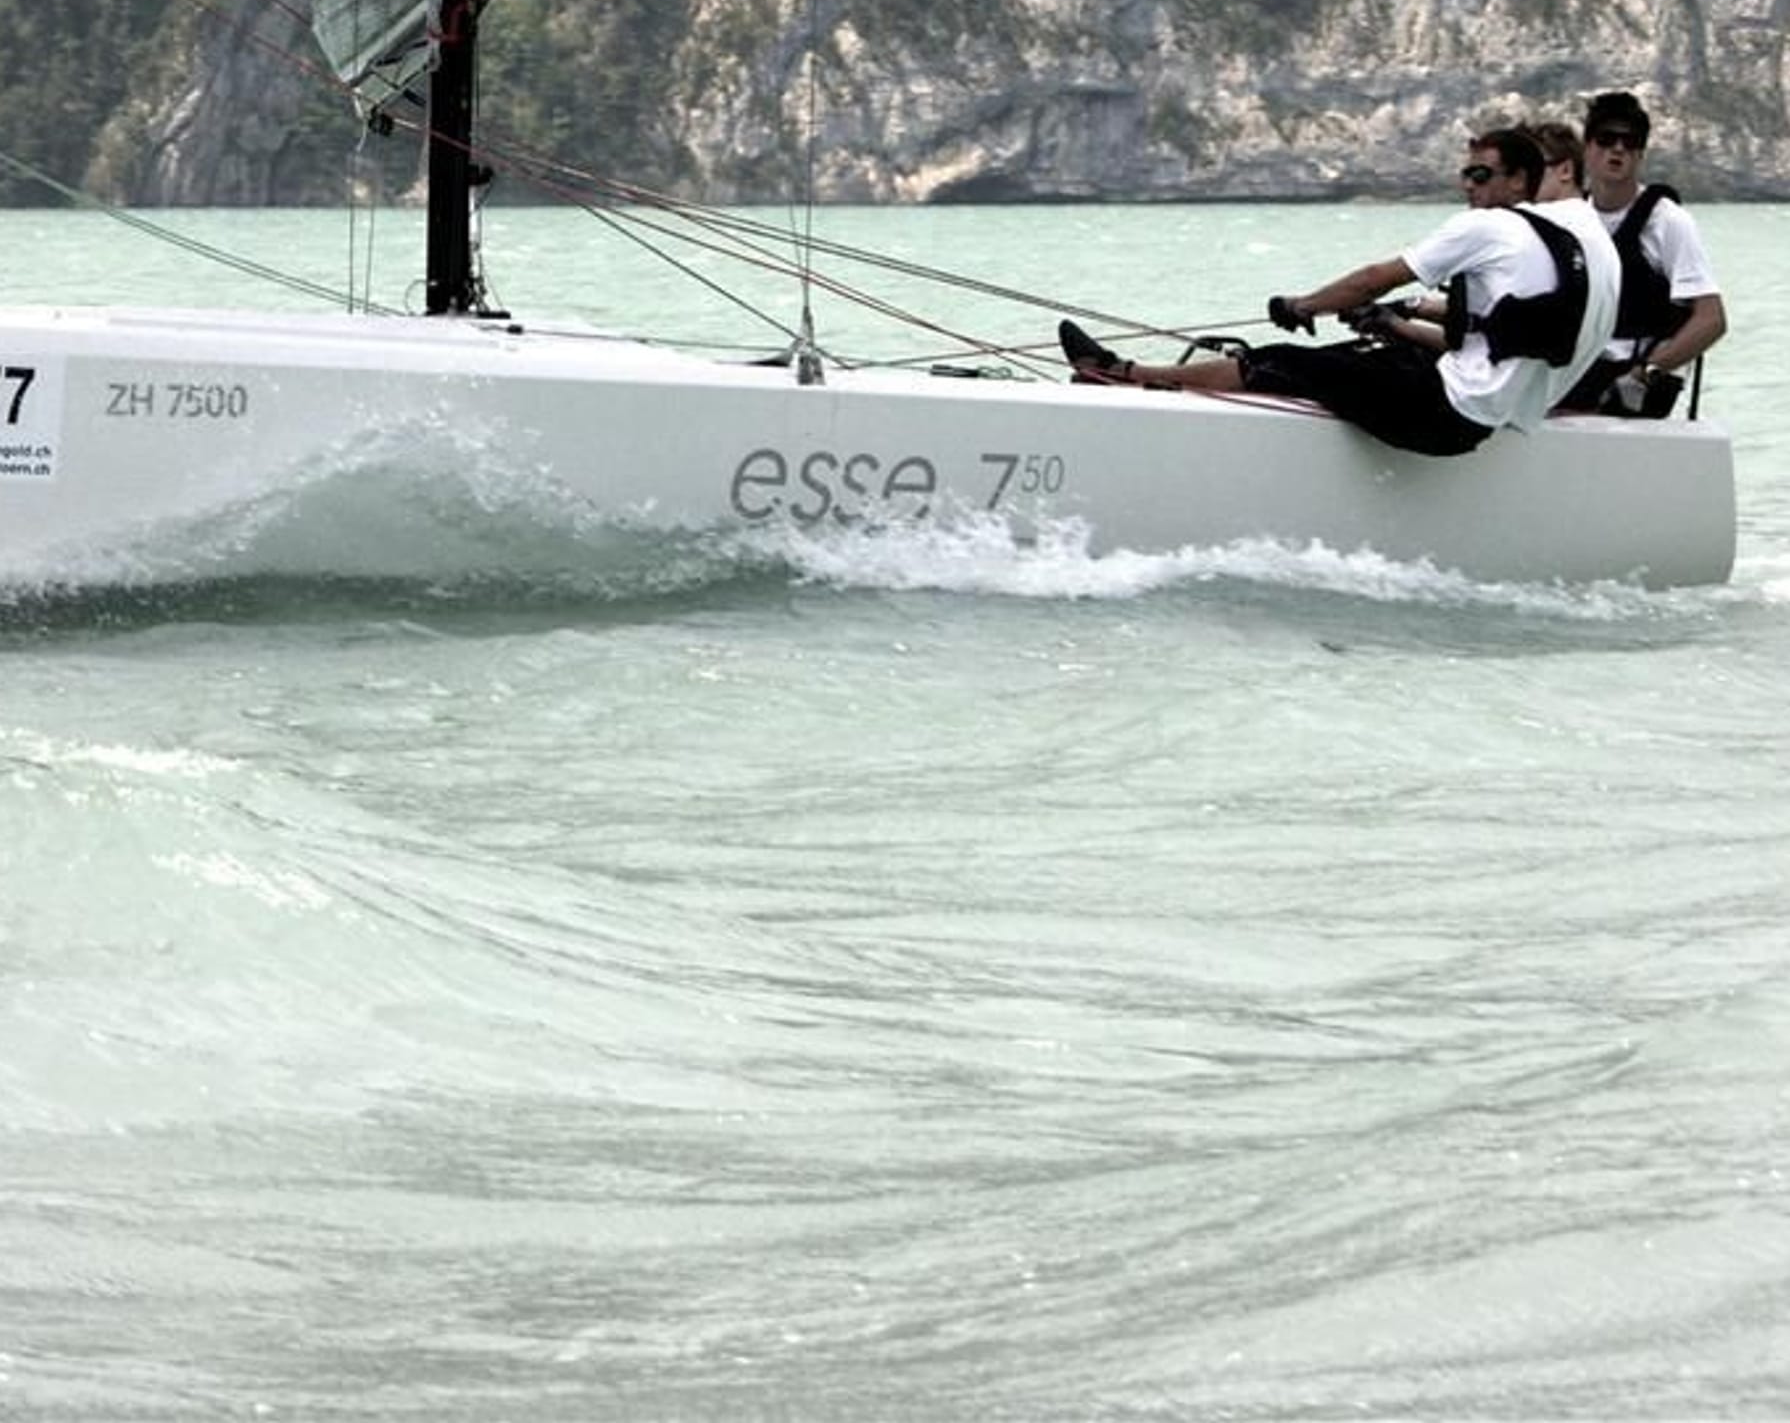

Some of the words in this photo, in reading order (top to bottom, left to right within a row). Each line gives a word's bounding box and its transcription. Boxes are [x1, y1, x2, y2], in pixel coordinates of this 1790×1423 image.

[0, 366, 35, 425] 7
[106, 383, 153, 416] ZH
[167, 383, 248, 418] 7500
[730, 448, 937, 522] esse
